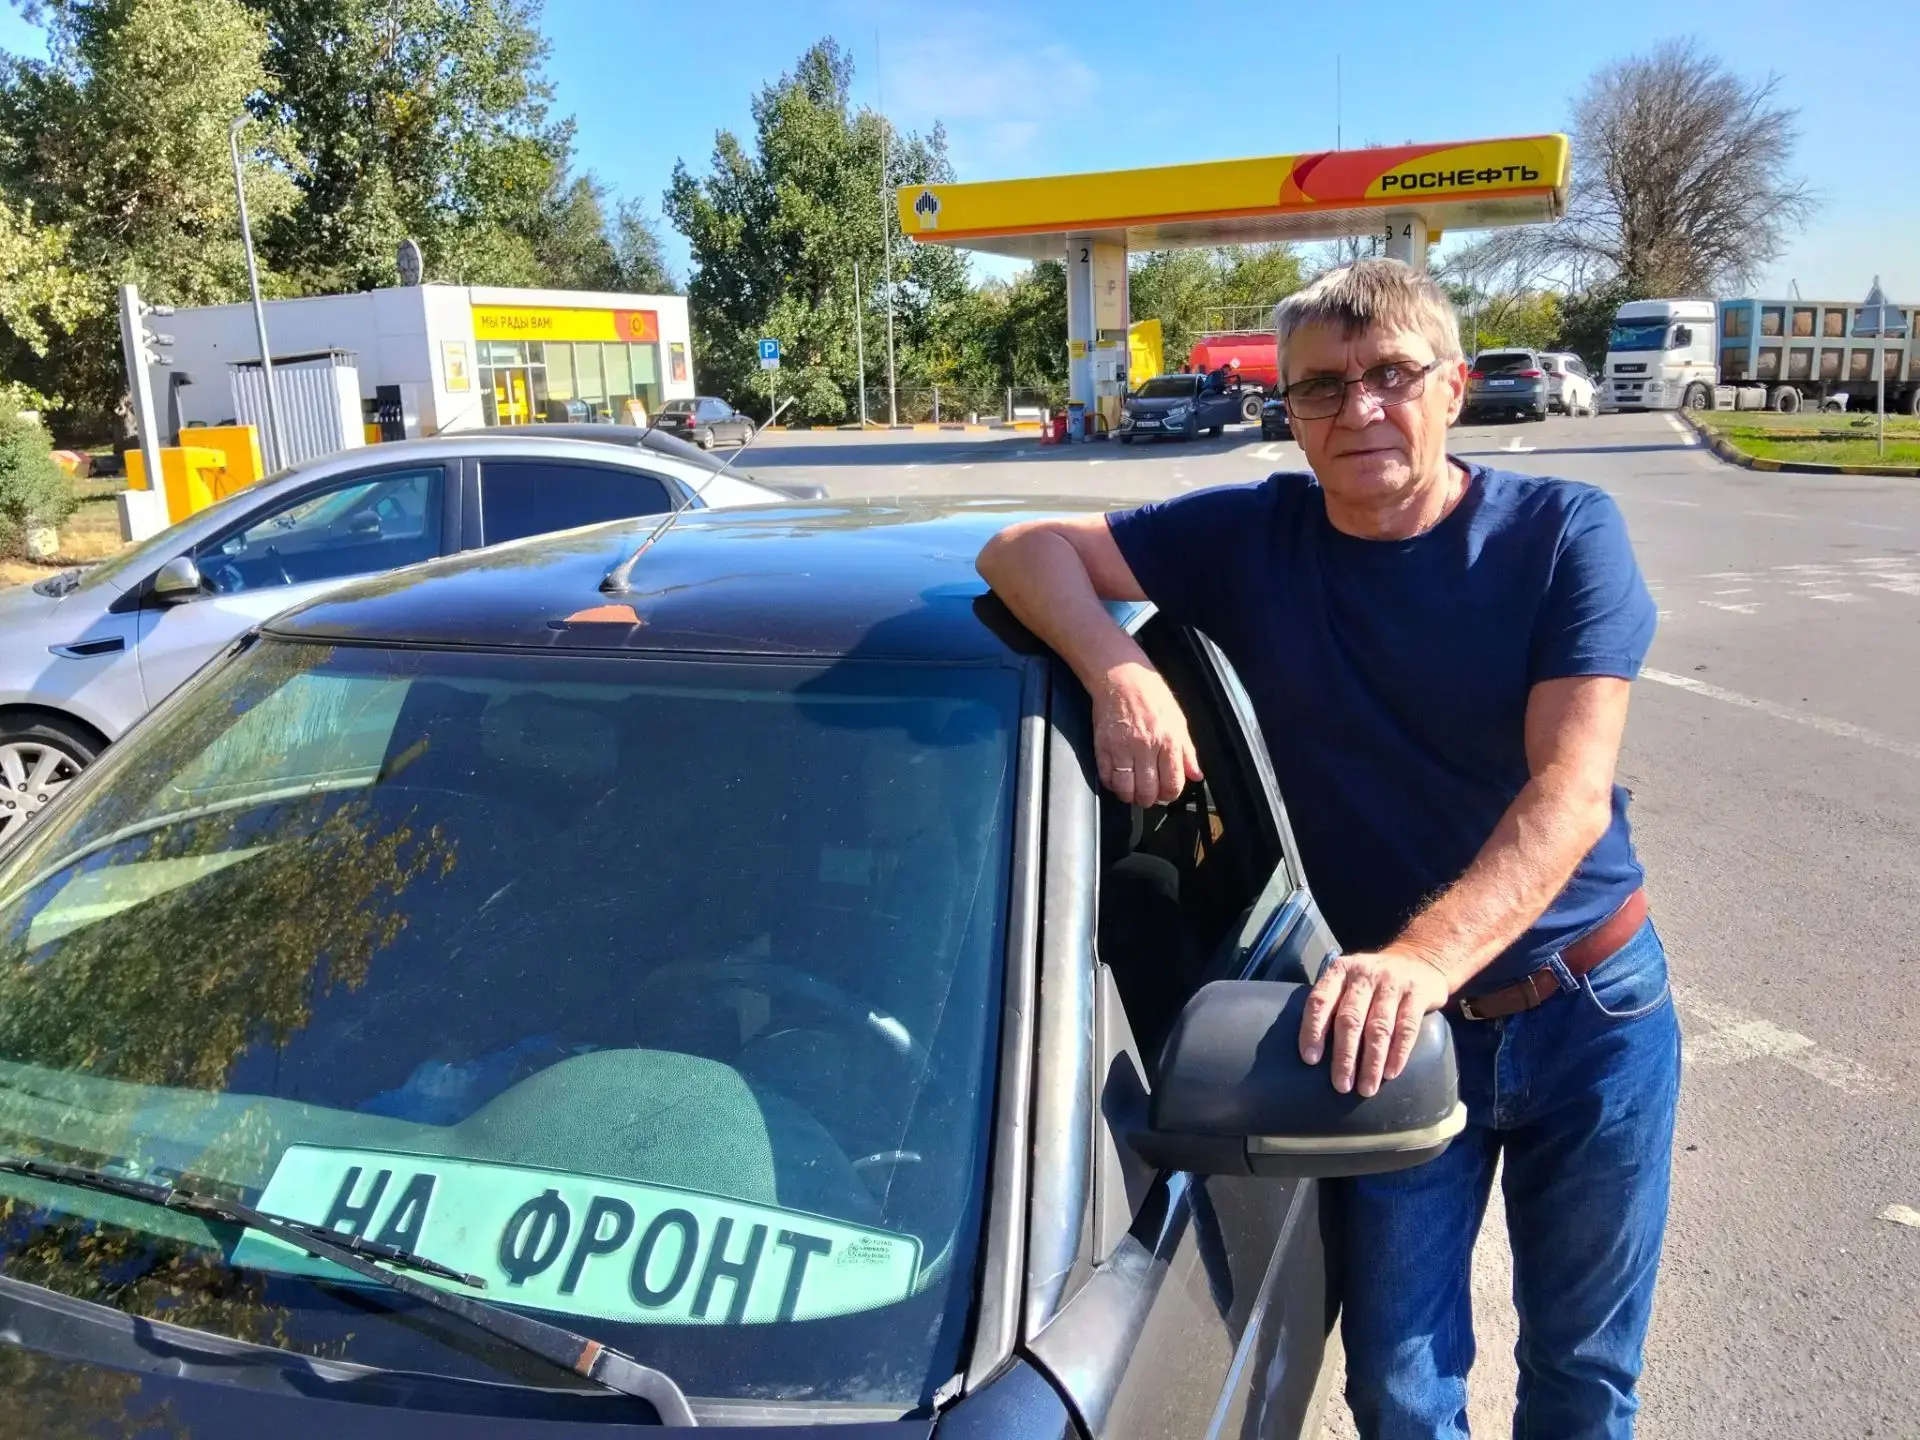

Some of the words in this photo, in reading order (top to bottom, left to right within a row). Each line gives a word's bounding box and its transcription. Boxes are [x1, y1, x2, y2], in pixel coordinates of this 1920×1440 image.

[1382, 166, 1539, 191] РОСНЕФТЬ
[1402, 224, 1412, 239] 4
[1080, 247, 1089, 263] 2
[481, 316, 498, 328] МЫ
[501, 317, 529, 329] РАДЫ
[531, 318, 553, 328] ВАМ!
[764, 342, 775, 357] P
[307, 1166, 437, 1269] НА
[496, 1189, 833, 1326] ФРОНТ
